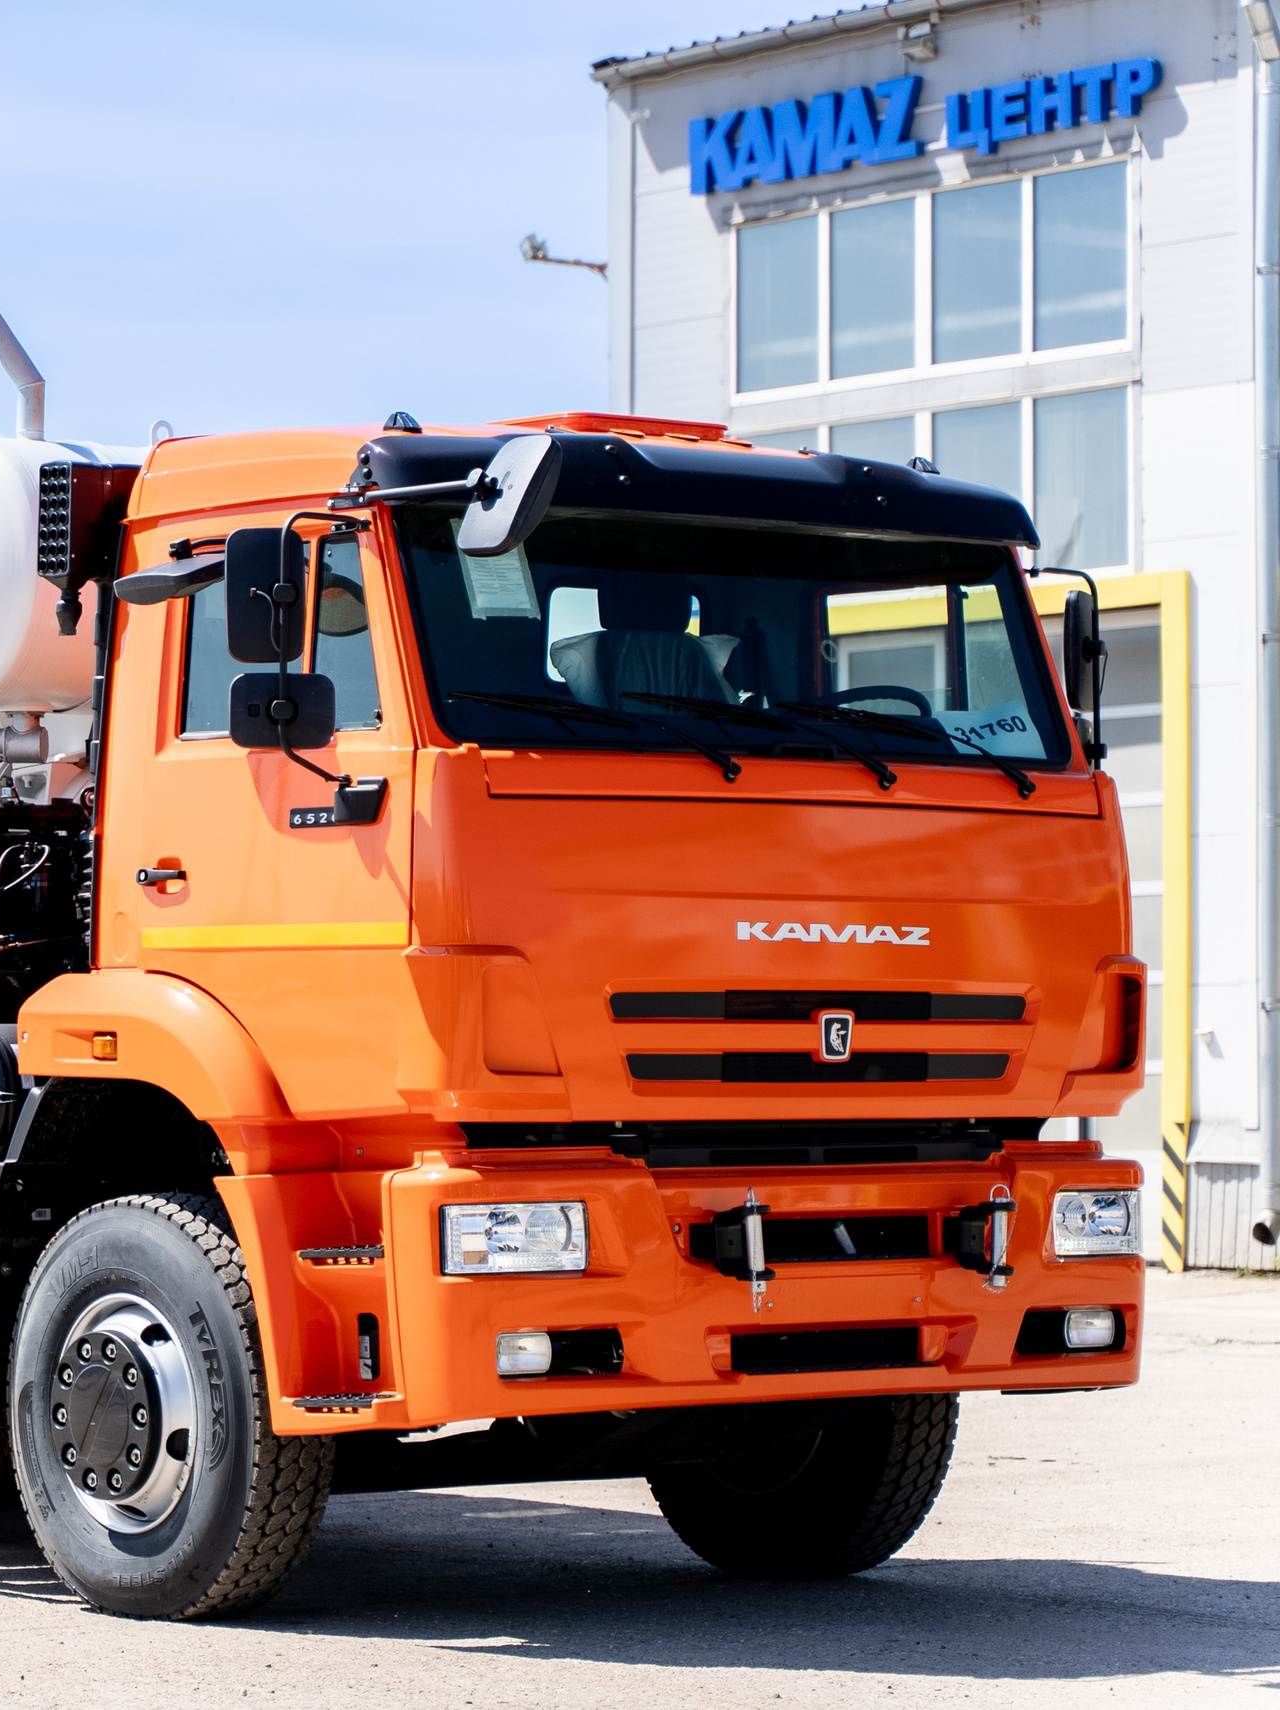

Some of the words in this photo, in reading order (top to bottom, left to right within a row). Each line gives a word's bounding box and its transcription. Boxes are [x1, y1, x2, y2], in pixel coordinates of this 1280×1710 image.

[688, 75, 923, 196] KAMAZ
[945, 57, 1161, 156] ЦЕНТР
[954, 715, 1027, 744] 31760
[736, 921, 930, 946] KAMAZ
[112, 1564, 167, 1588] STEEL
